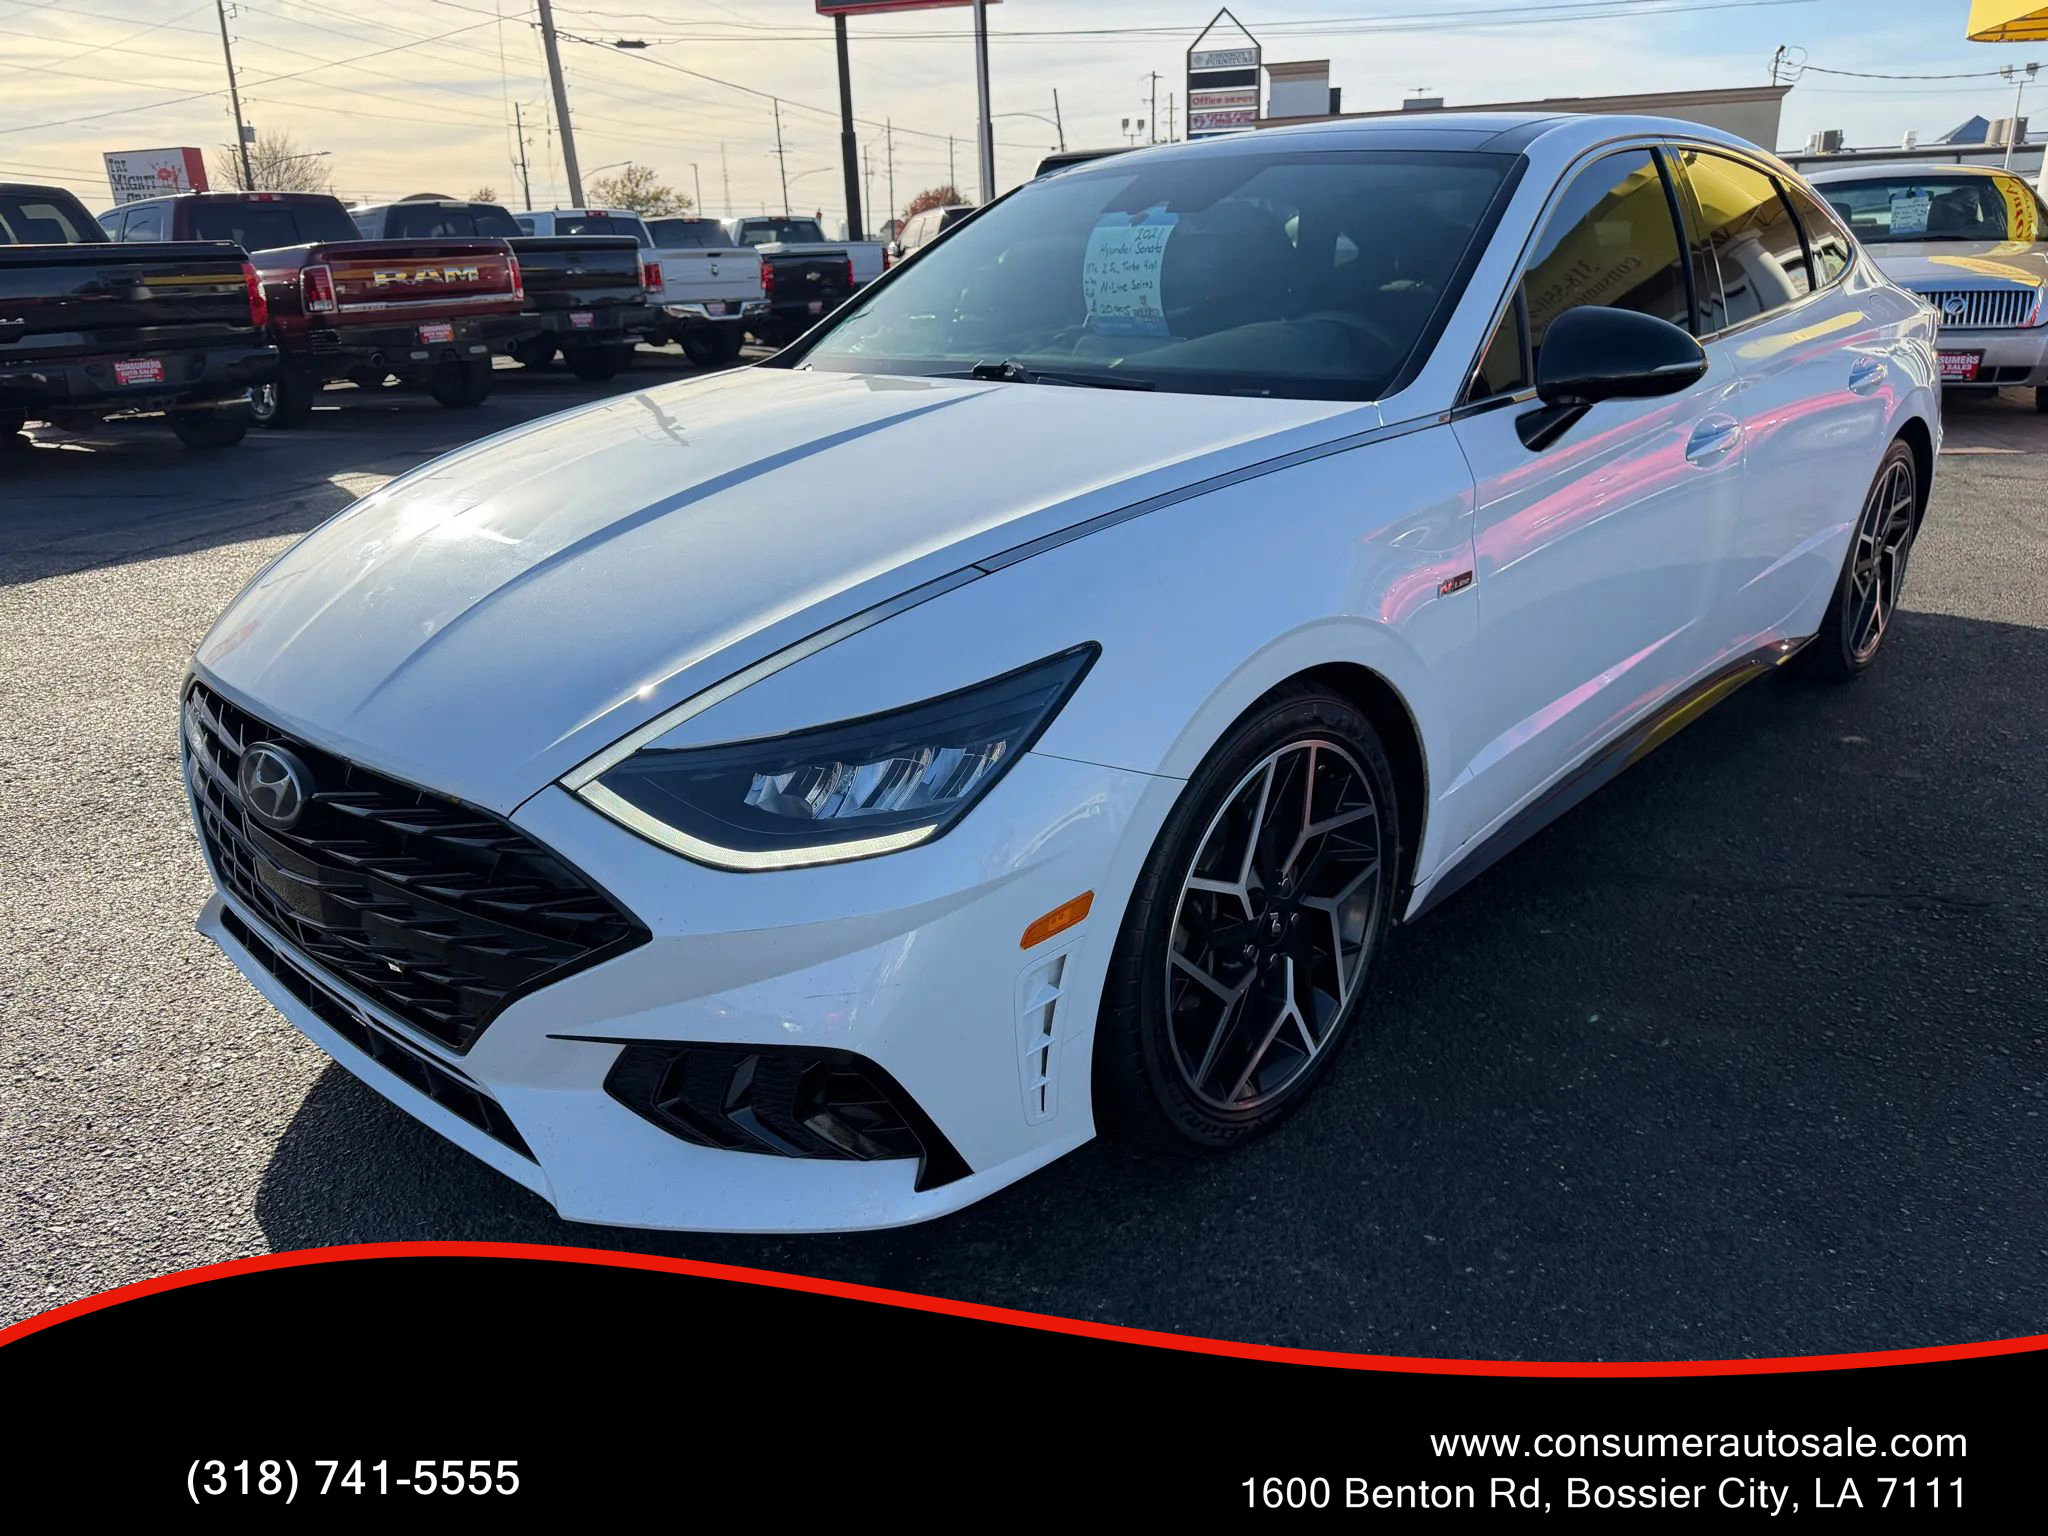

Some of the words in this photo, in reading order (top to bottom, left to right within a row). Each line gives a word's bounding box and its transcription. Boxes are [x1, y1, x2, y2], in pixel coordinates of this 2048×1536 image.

[1192, 96, 1222, 105] Office
[111, 173, 157, 191] MIGHTY
[1135, 227, 1164, 242] 2021
[372, 265, 480, 288] RAM
[114, 360, 161, 372] CONSUMERS
[1938, 355, 1980, 365] SUMERS
